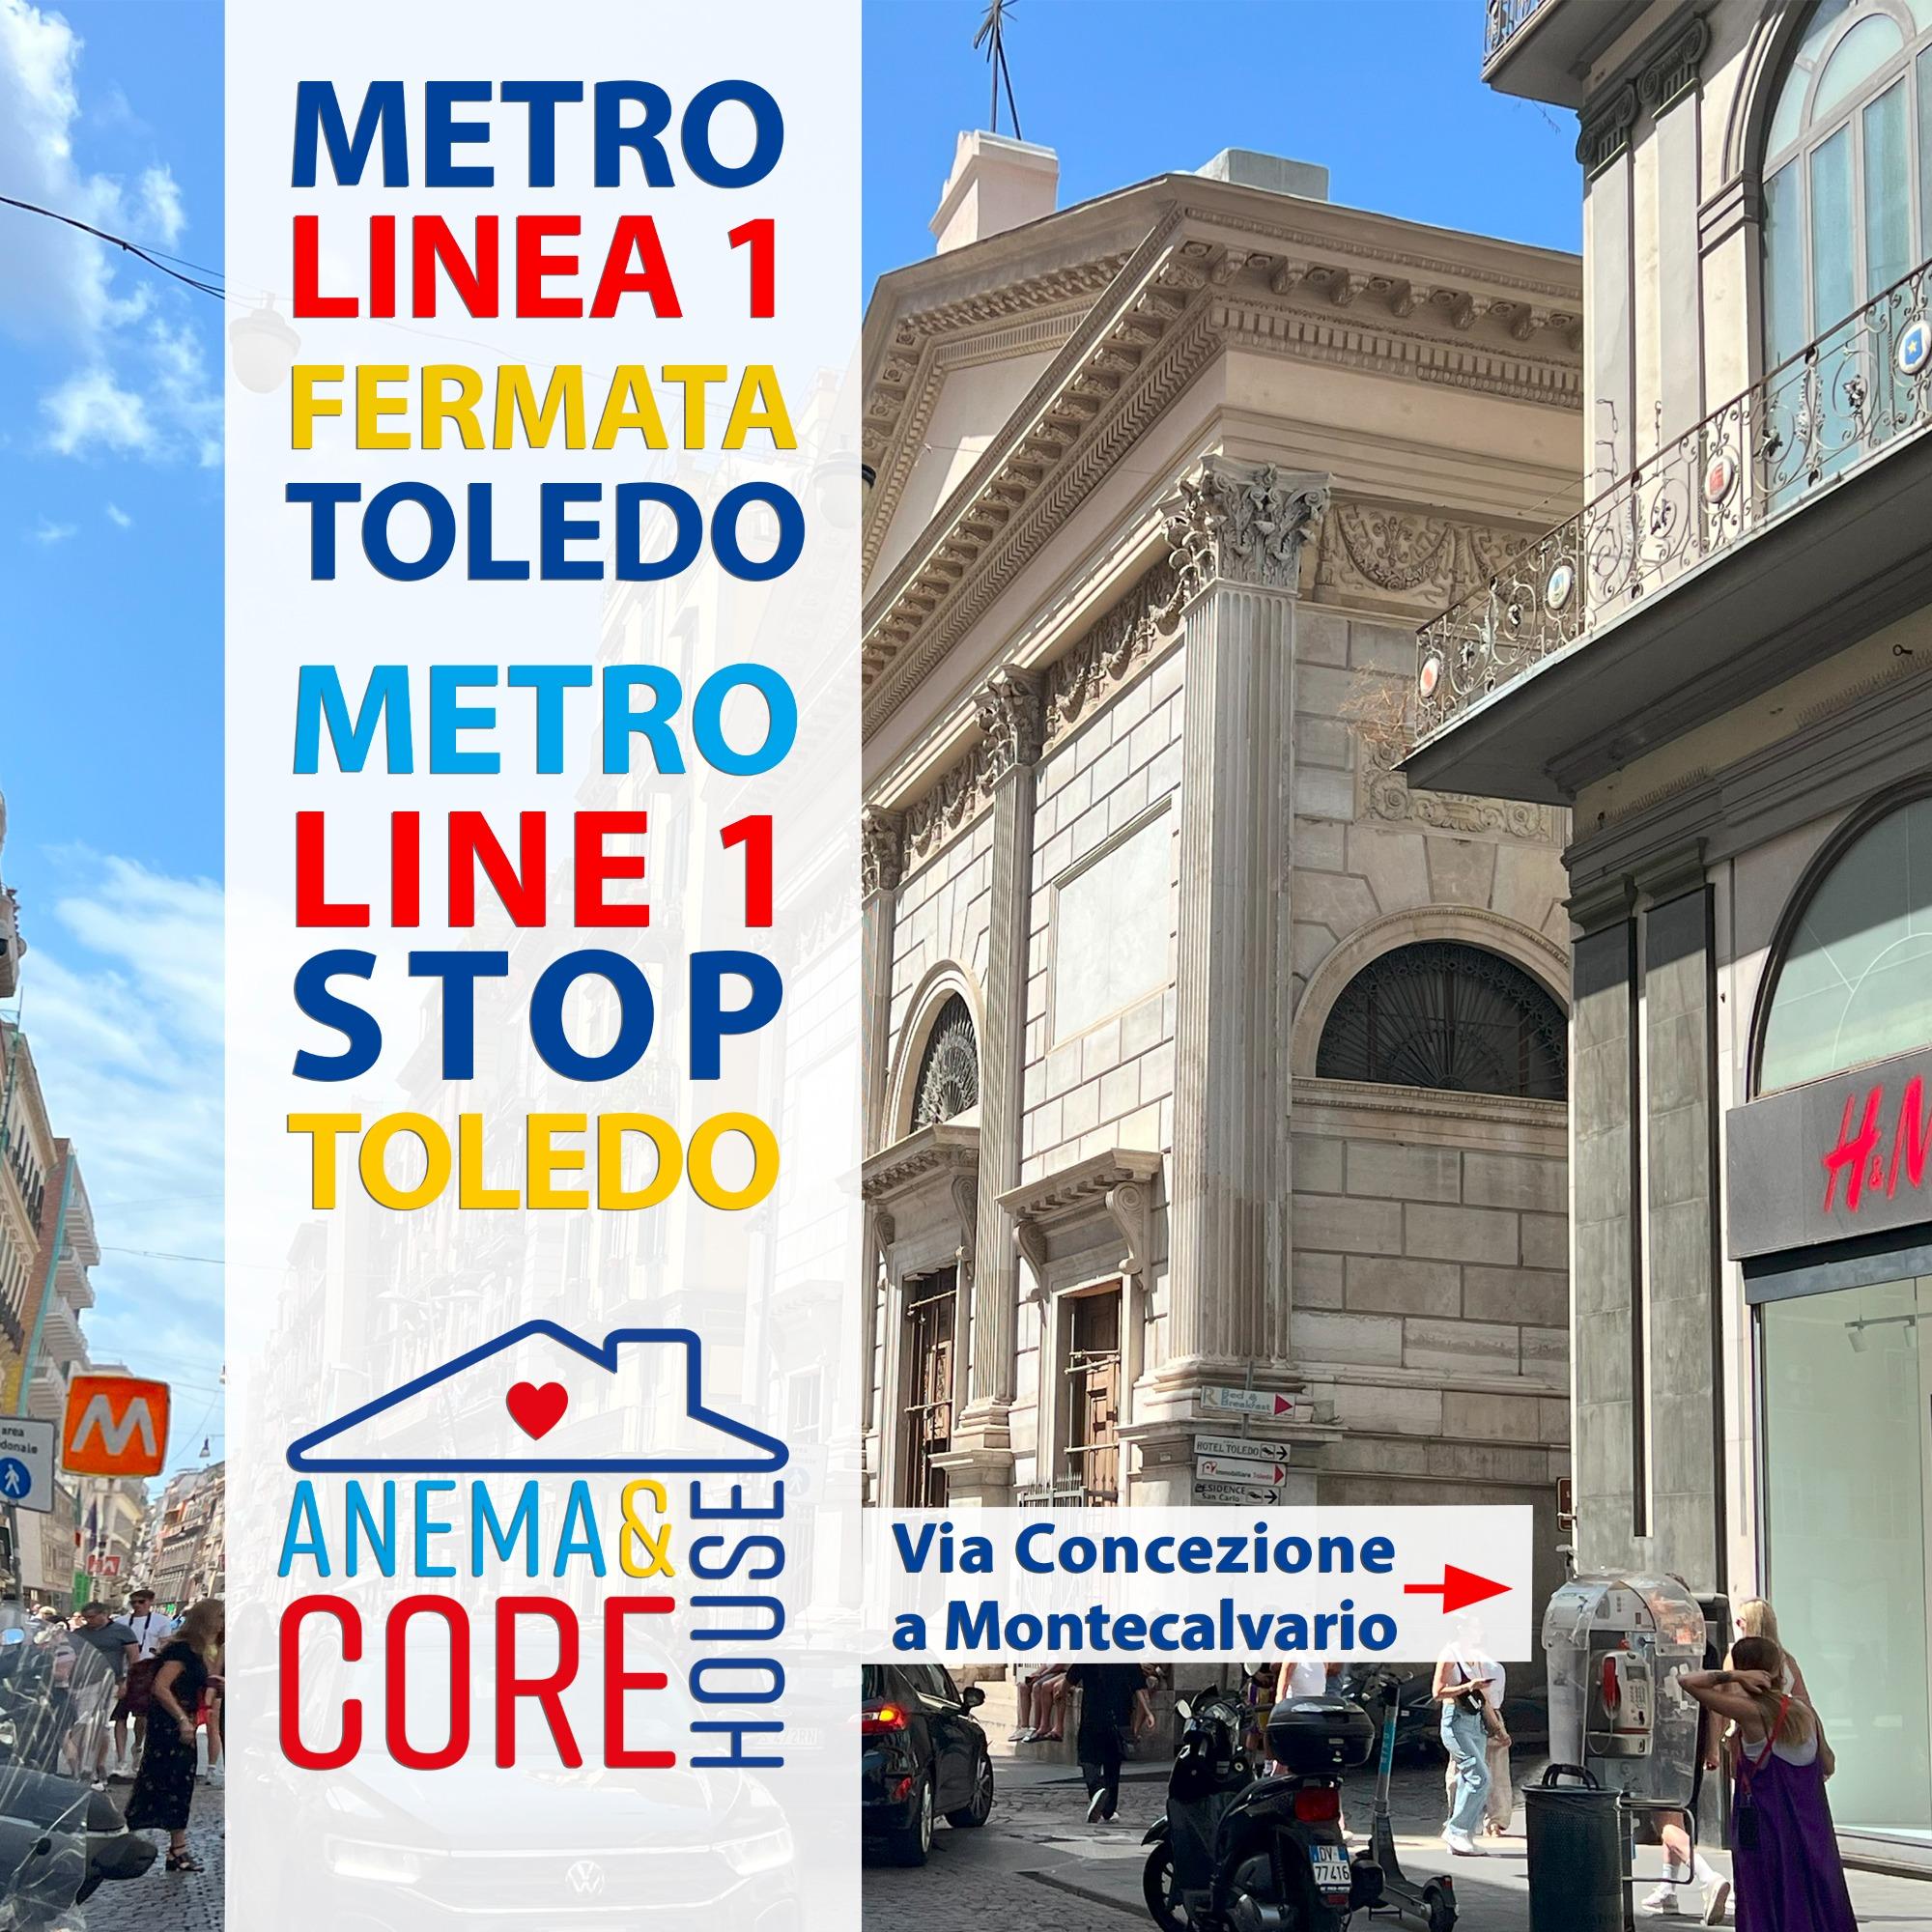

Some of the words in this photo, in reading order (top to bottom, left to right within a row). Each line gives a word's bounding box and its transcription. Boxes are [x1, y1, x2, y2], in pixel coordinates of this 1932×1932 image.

[1823, 1073, 1932, 1213] H&M
[1221, 1388, 1244, 1400] Bed
[1220, 1397, 1271, 1411] Breakfast
[2, 1427, 24, 1436] area
[71, 1394, 157, 1457] M
[0, 1439, 38, 1454] donale
[1197, 1440, 1225, 1453] HOTEL
[1227, 1443, 1260, 1456] TOLEDO
[1219, 1493, 1240, 1502] Carlo
[1319, 1846, 1333, 1861] DV
[1315, 1865, 1350, 1882] 77416
